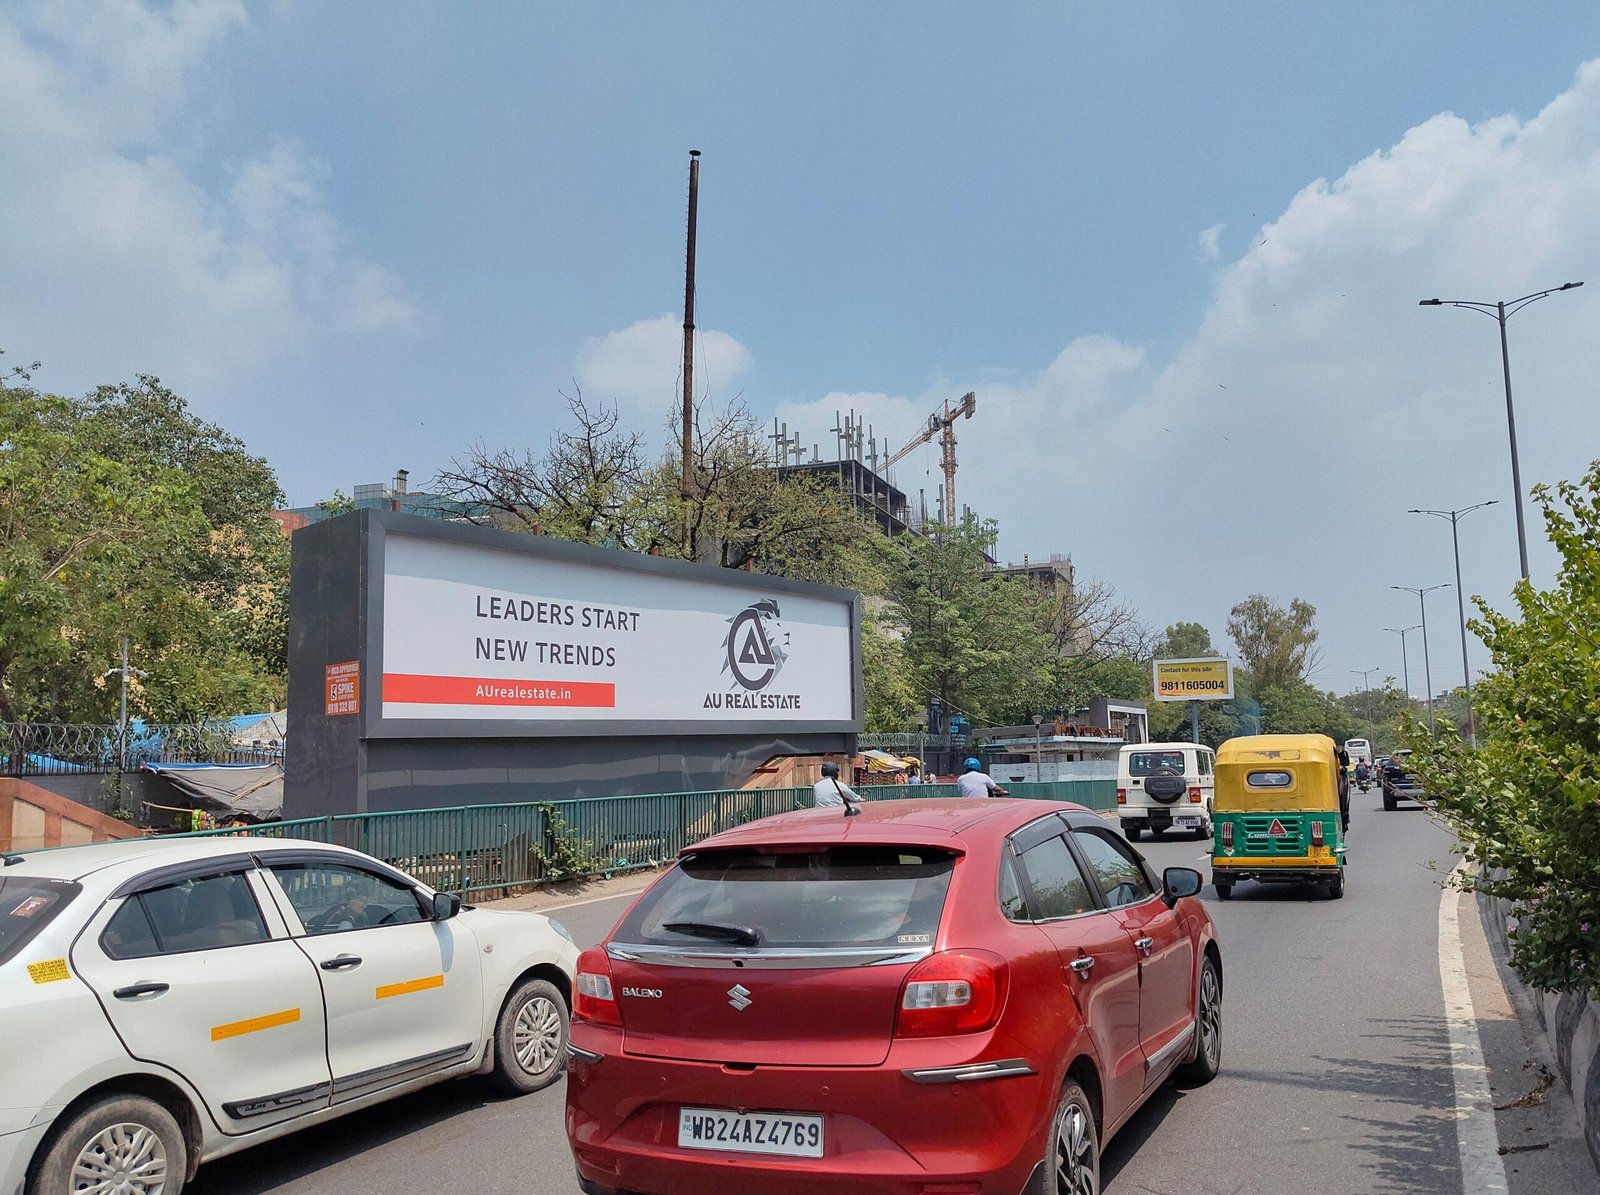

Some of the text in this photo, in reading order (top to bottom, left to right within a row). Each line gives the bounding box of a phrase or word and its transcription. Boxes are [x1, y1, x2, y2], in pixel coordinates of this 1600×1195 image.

[476, 595, 640, 632] LEADERS START
[475, 637, 616, 667] NEW TRENDS
[338, 683, 354, 694] SPIKE
[475, 684, 571, 700] AUrealestate.in
[1161, 680, 1225, 691] 9811605004
[703, 693, 801, 709] AU REAL ESTATE
[898, 935, 929, 943] NEXA
[622, 987, 663, 999] BALENO
[682, 1124, 692, 1132] IND
[692, 1116, 819, 1147] WB24AZ4769
